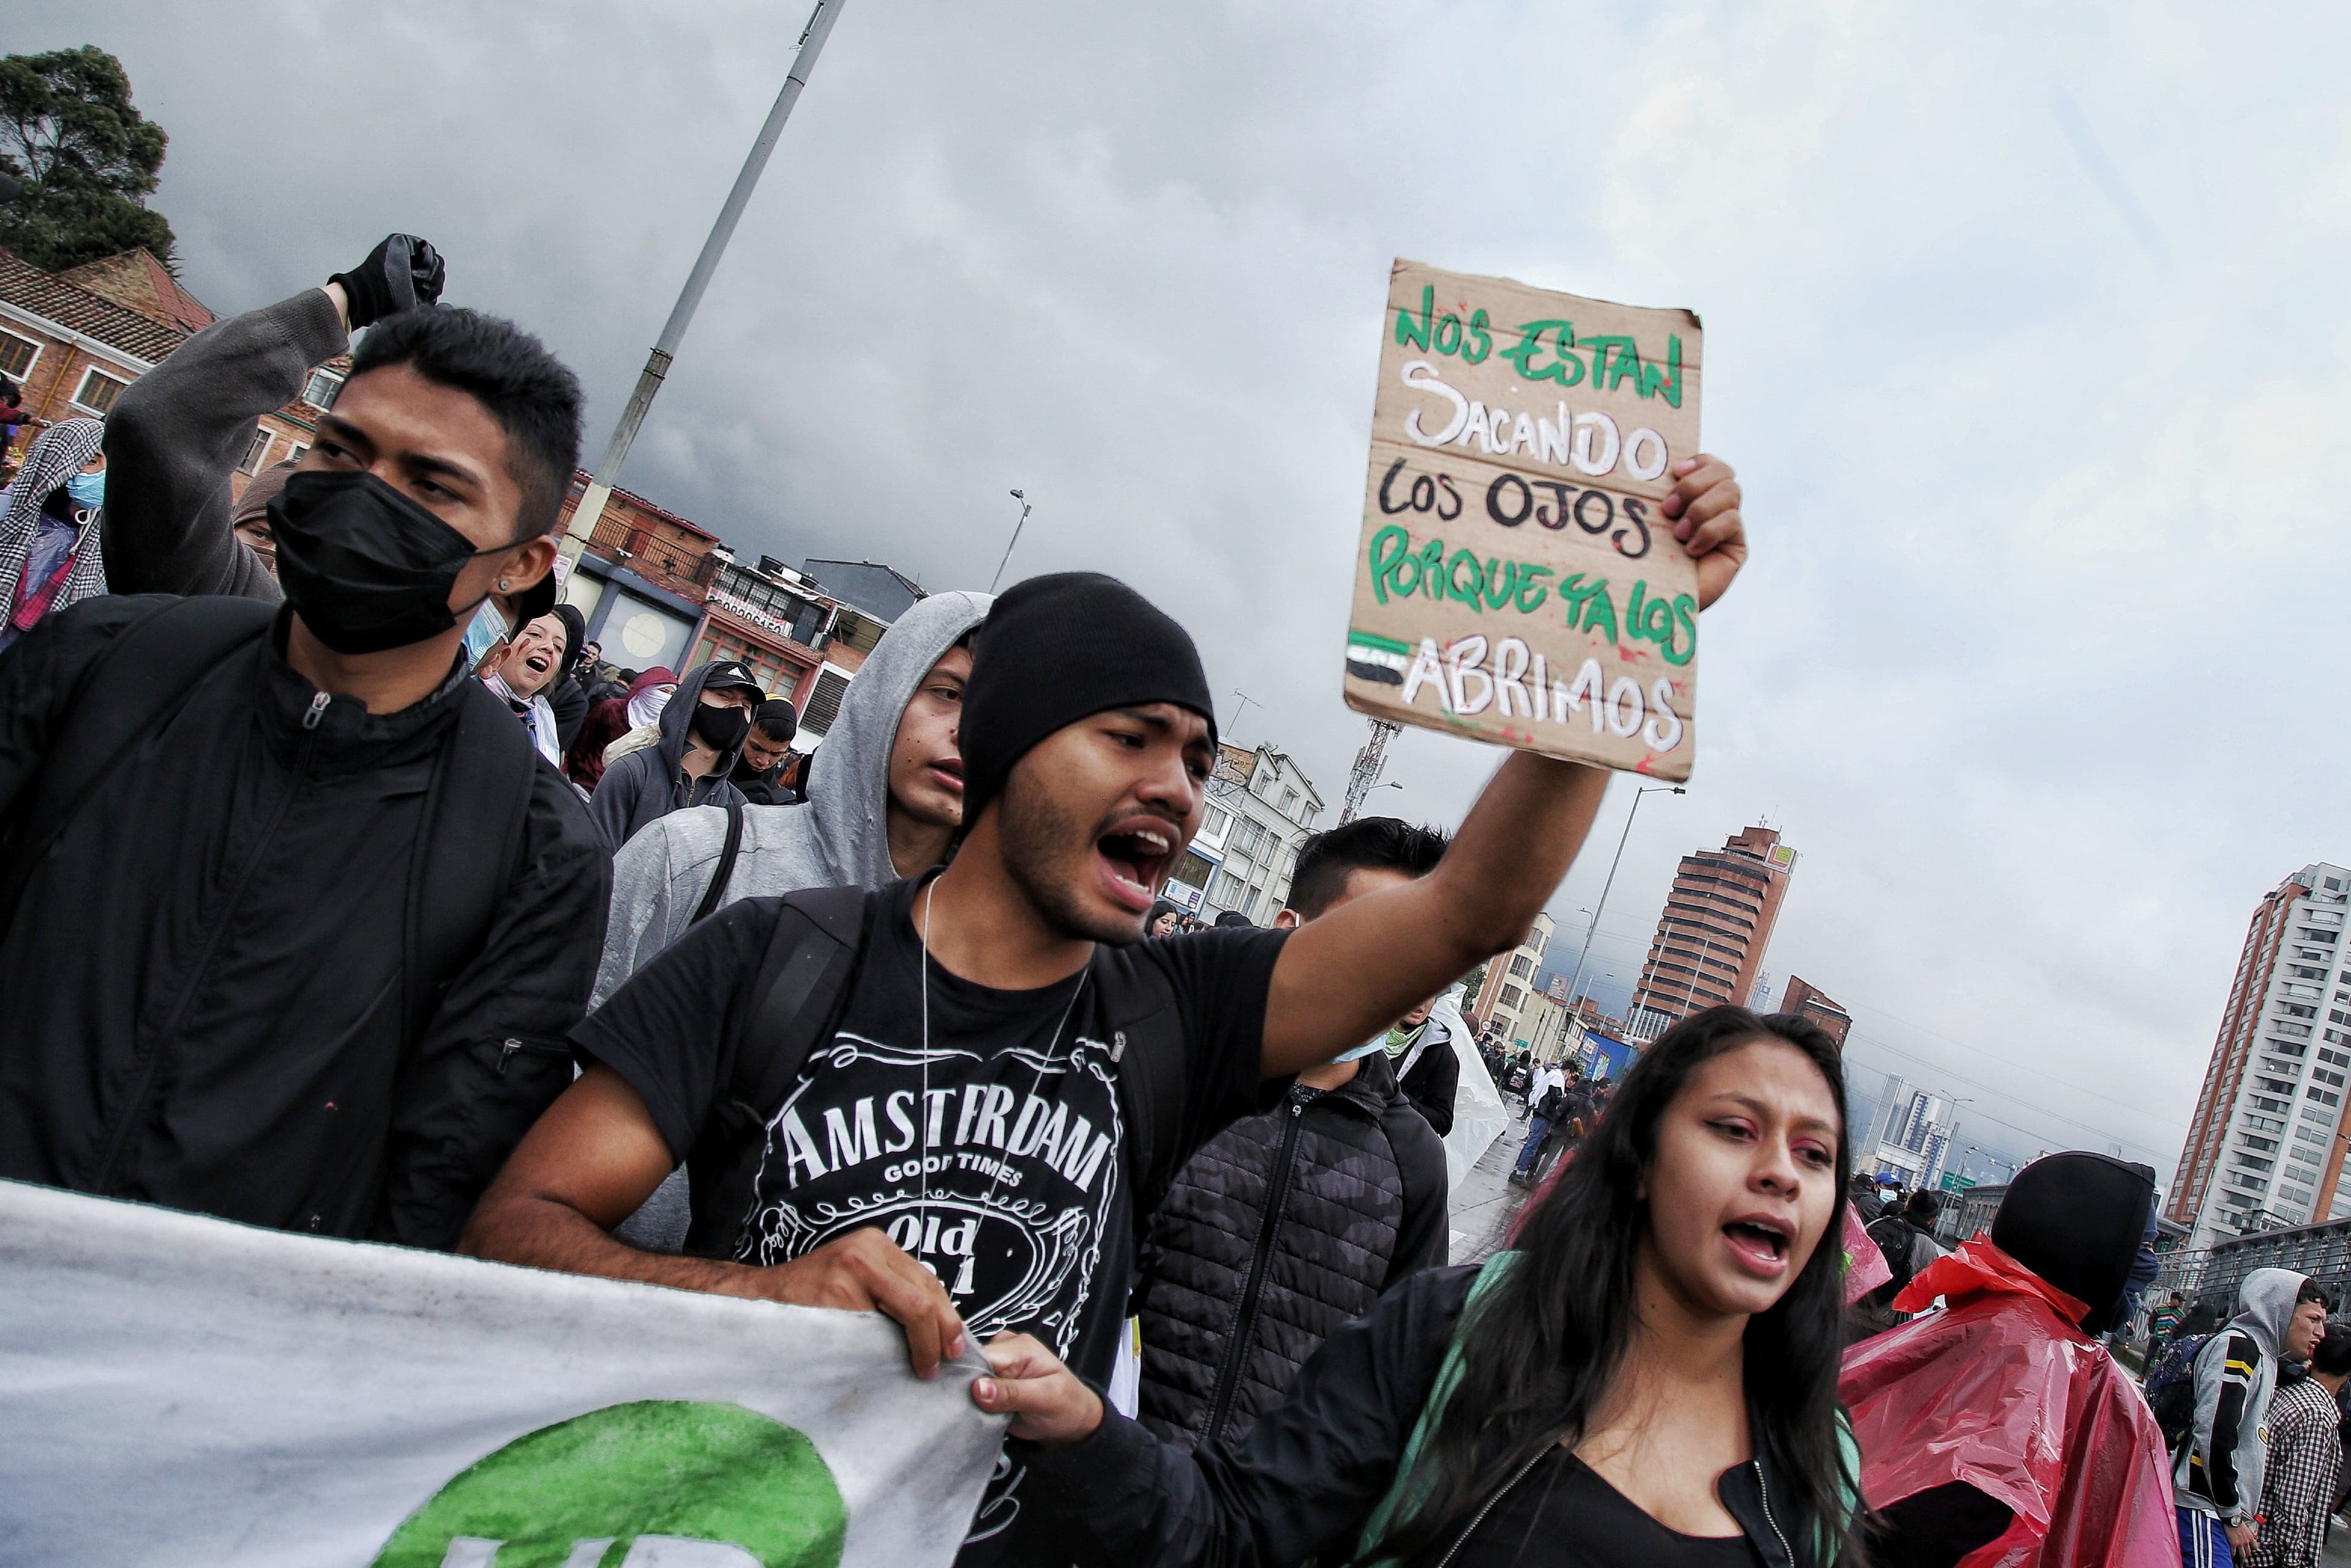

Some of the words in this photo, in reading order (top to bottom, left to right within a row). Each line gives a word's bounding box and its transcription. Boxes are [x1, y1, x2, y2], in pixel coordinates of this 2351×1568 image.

[1395, 284, 1492, 364] NOS
[1499, 320, 1682, 408] ESTAN
[1400, 359, 1668, 481] SACANDO
[1379, 457, 1462, 520] LOS
[1487, 473, 1651, 558] OJOS
[1370, 525, 1554, 613] PORQUE
[1559, 572, 1618, 645] YA
[1625, 579, 1697, 666] LOS
[1401, 634, 1683, 752] ABRIMOS
[956, 1151, 1022, 1187] TIMES
[887, 1215, 977, 1256] Old
